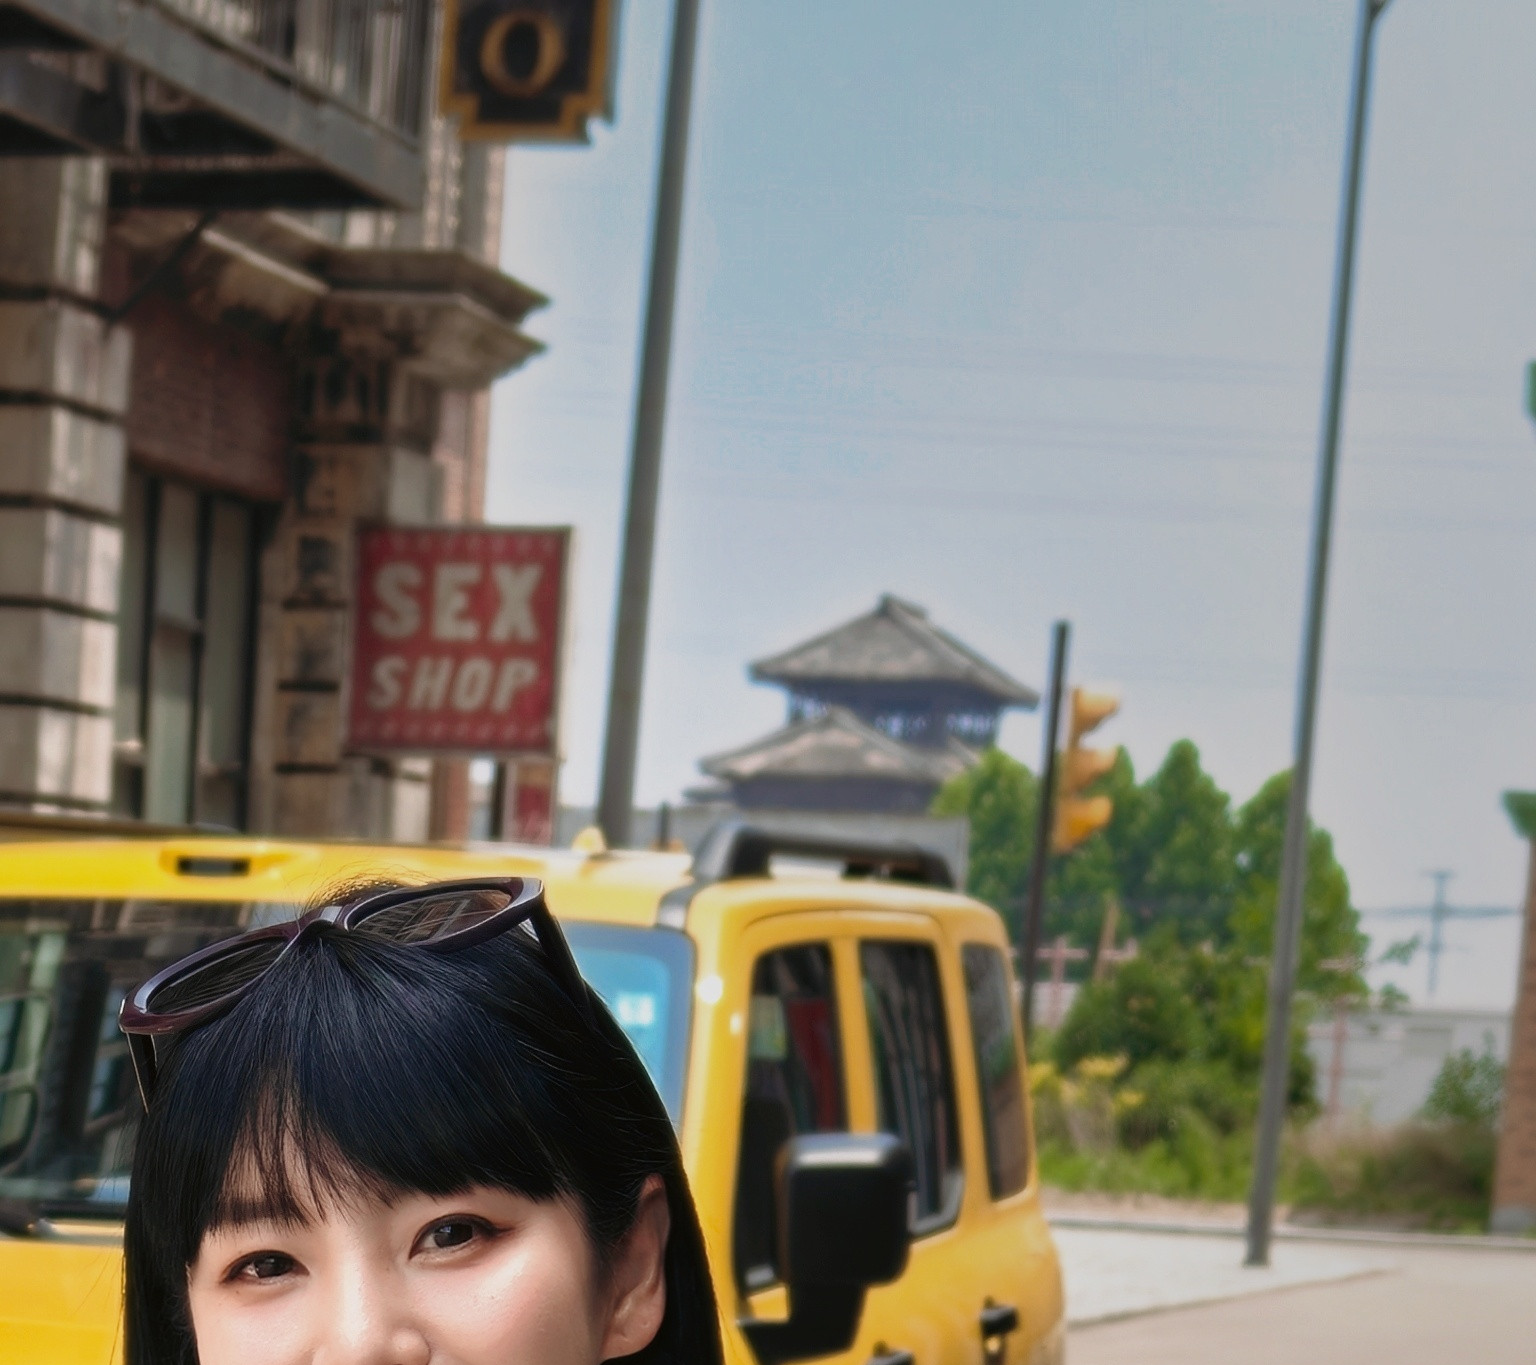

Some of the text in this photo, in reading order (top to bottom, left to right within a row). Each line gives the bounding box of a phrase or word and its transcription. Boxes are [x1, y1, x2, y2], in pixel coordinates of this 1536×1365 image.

[478, 9, 567, 99] O
[370, 561, 546, 643] SEX
[366, 654, 539, 714] SHOP
